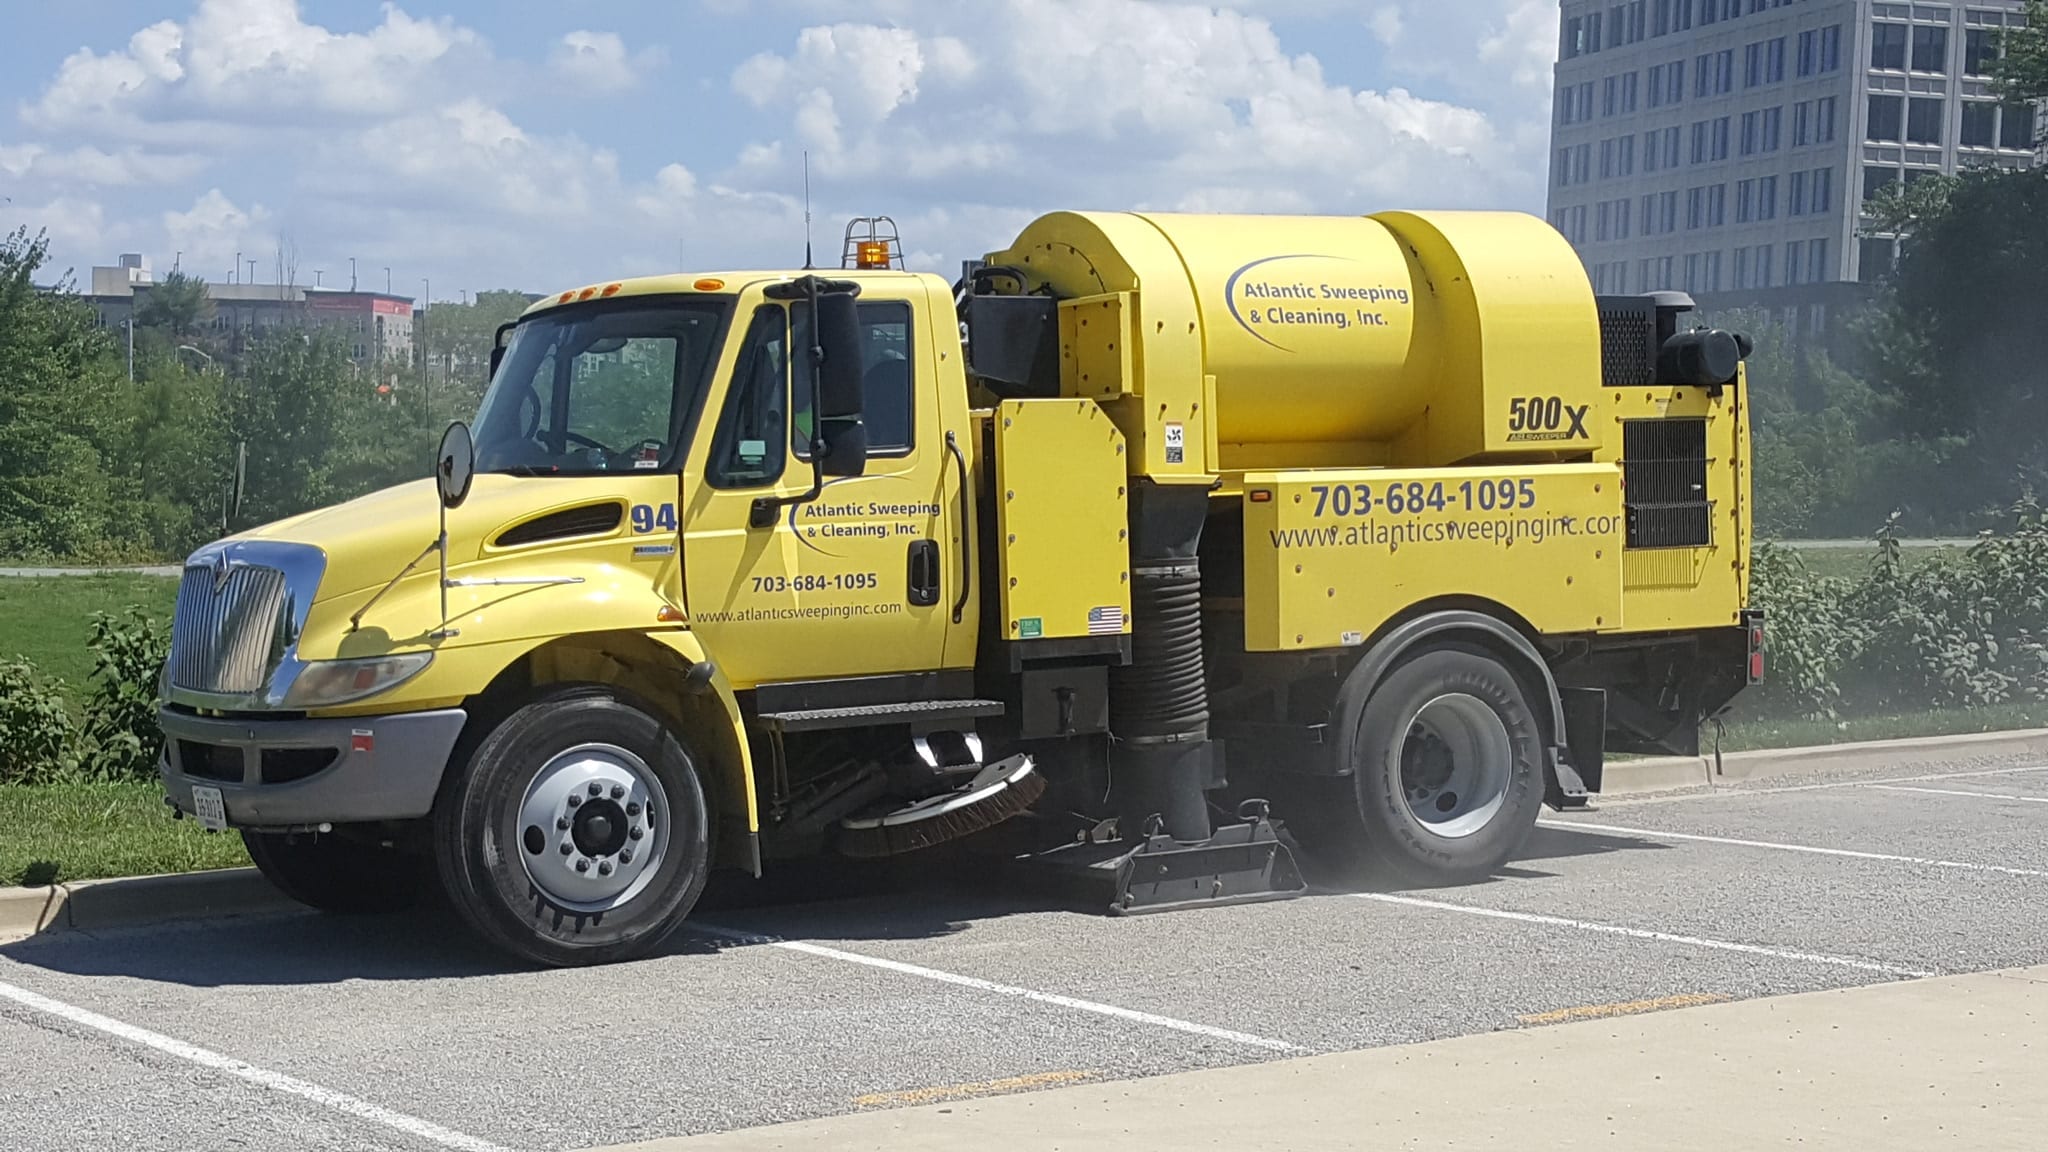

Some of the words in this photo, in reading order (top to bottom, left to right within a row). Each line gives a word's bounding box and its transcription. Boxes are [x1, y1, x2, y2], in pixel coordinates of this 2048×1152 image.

[1245, 283, 1316, 299] Atlantic
[1320, 284, 1409, 304] Sweeping
[1250, 310, 1261, 324] &
[1267, 307, 1351, 328] Cleaning,
[1356, 309, 1388, 326] Inc.
[1311, 478, 1536, 517] 703-684-1095
[631, 503, 677, 533] 94
[805, 502, 864, 518] Atlantic
[869, 501, 940, 517] Sweeping
[807, 528, 816, 538] &
[821, 523, 890, 538] Cleaning,
[895, 523, 920, 535] Inc.
[751, 573, 877, 593] 703-684-1095
[695, 602, 901, 624] www.atlanticsweepinginc.com
